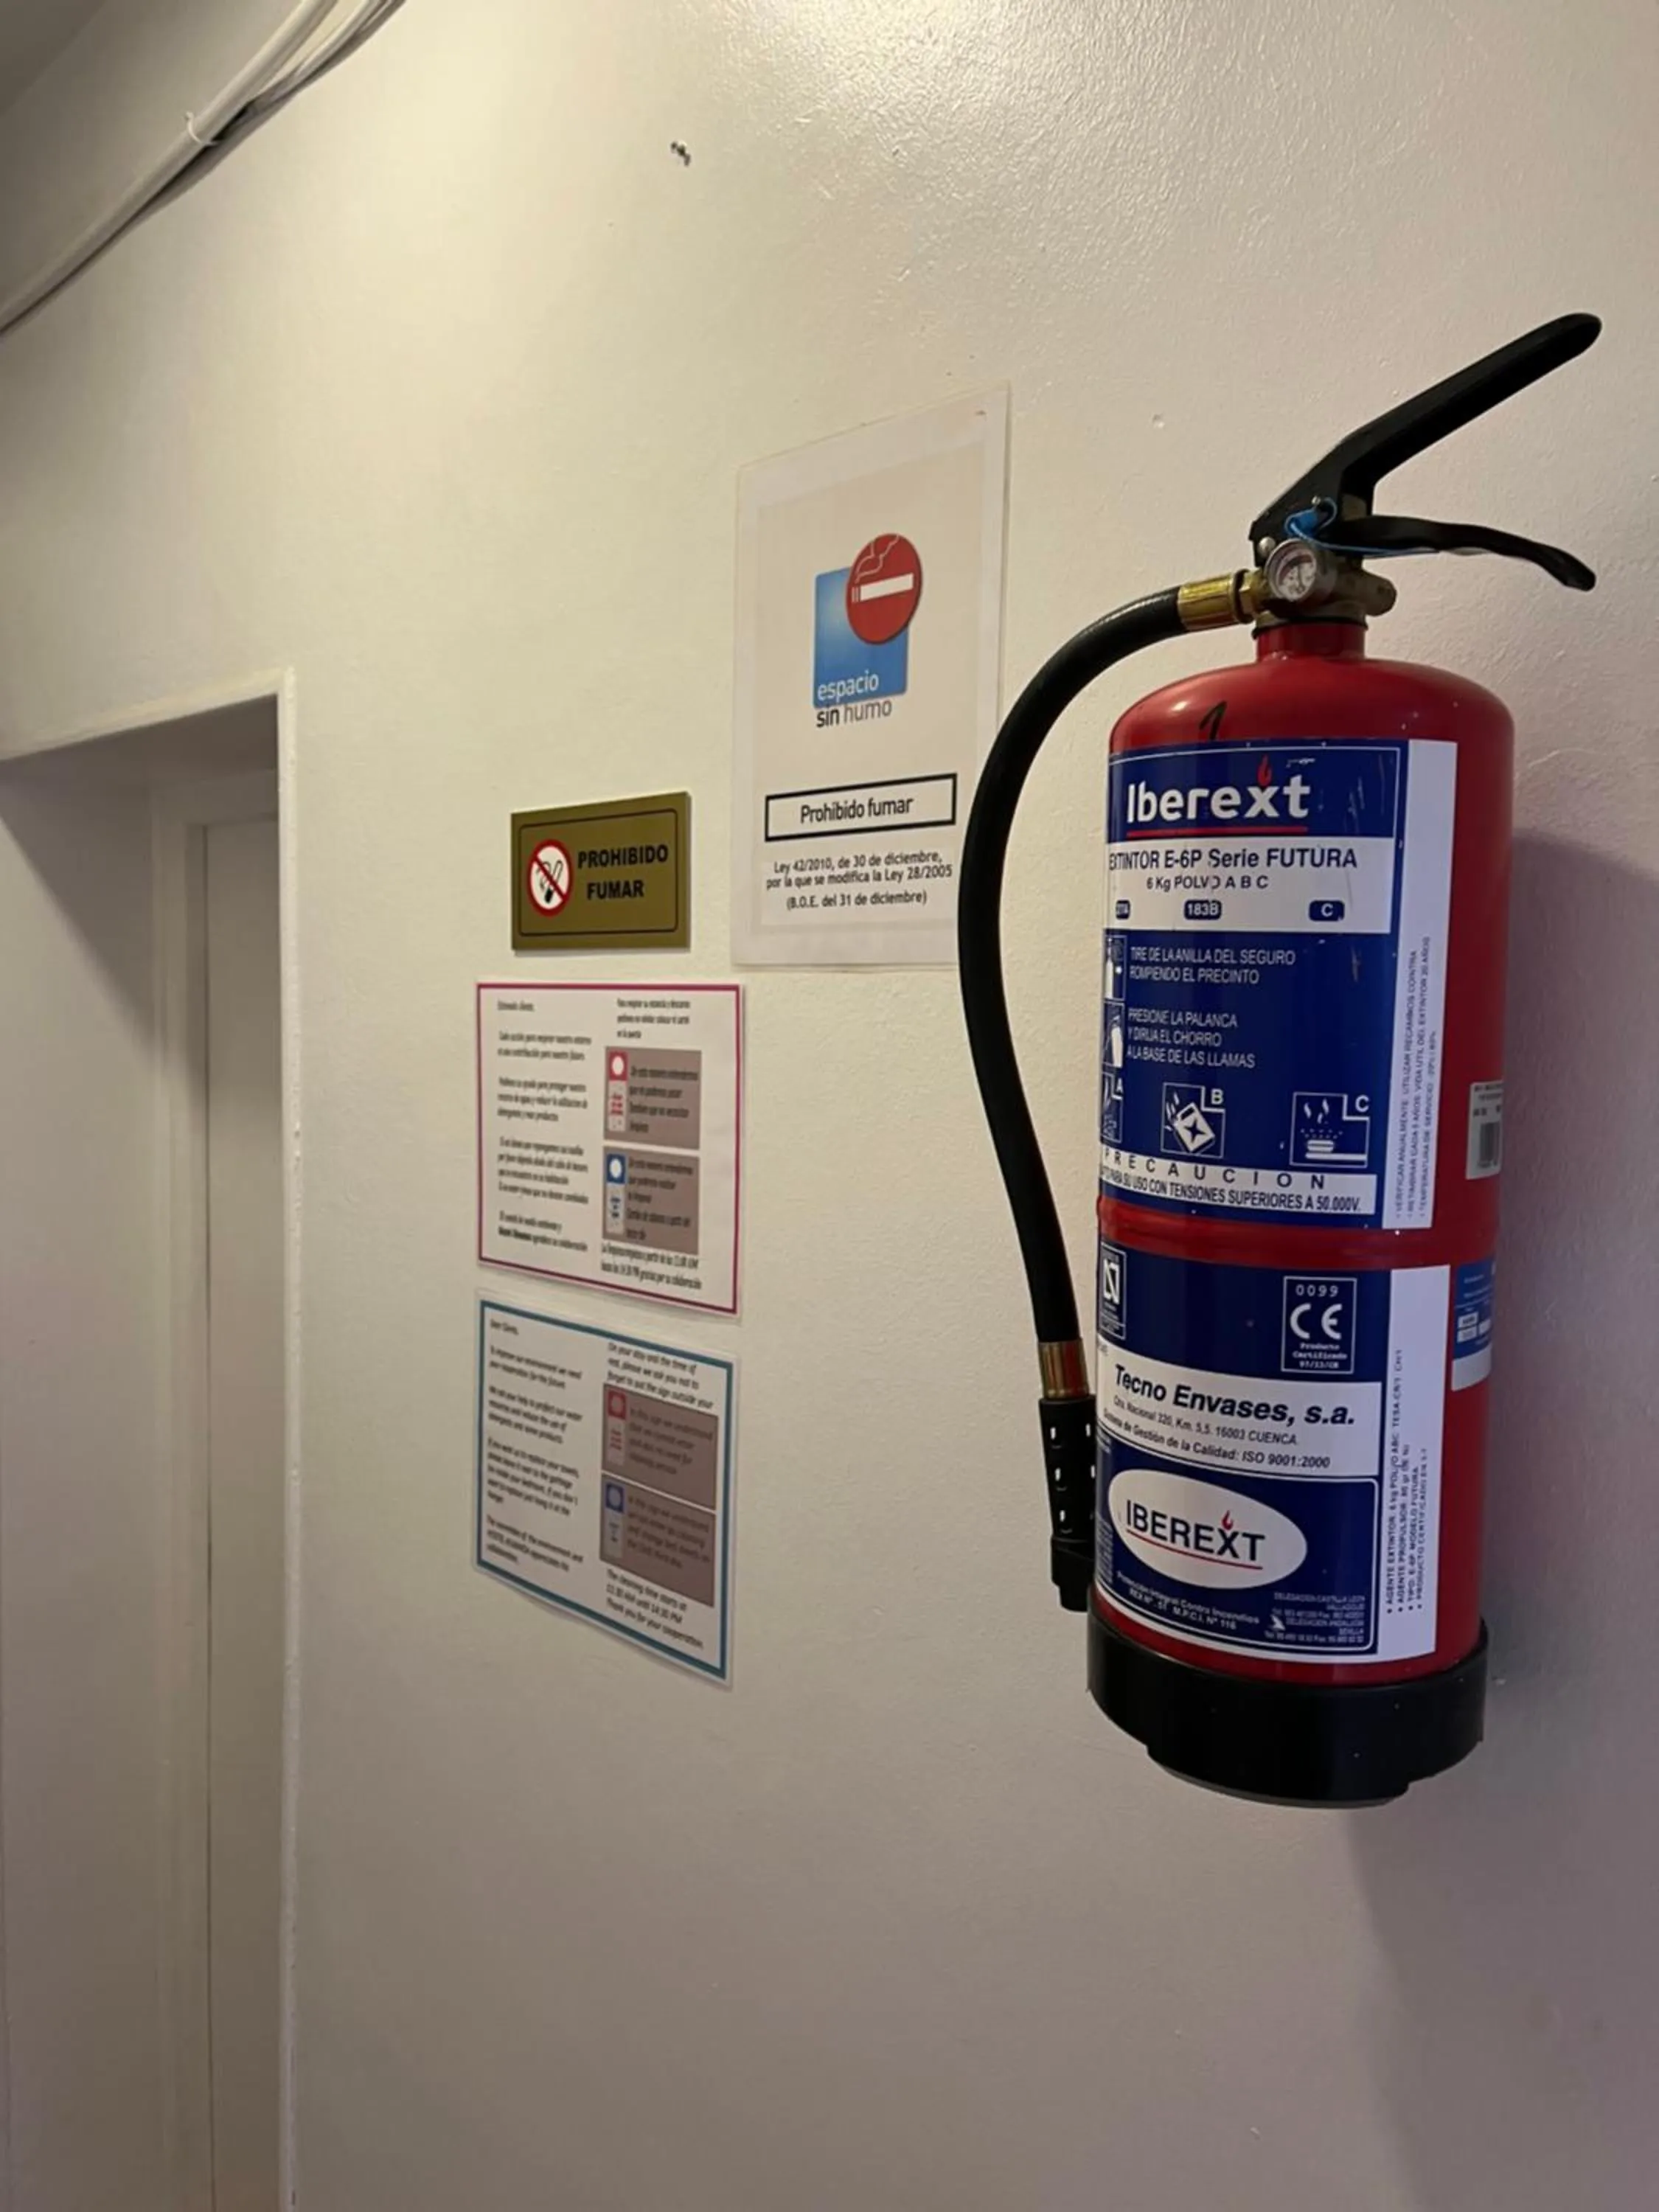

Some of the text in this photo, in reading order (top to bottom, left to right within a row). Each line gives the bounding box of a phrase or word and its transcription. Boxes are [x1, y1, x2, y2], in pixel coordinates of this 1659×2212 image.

[818, 669, 880, 701] espacio
[816, 700, 892, 728] sin humo
[800, 796, 914, 824] Prohibido fumar
[1127, 774, 1311, 824] Iberext
[578, 844, 668, 869] PROHIBIDO
[774, 850, 942, 877] Ley 42/2010, de 30 de diciembre,
[1164, 849, 1203, 869] E-6P
[1208, 848, 1259, 869] Serie
[1266, 848, 1357, 869] FUTURA
[766, 864, 953, 890] por la que se modifica la Ley 28/2005
[1147, 877, 1152, 889] 6
[1155, 877, 1171, 892] Kg
[1225, 875, 1236, 888] A
[1241, 875, 1251, 888] B
[1256, 875, 1269, 888] C
[587, 880, 644, 900] FUMAR
[786, 889, 928, 911] (B.O.E. del 31 de diciembre)
[1187, 902, 1220, 916] 183B
[1321, 903, 1333, 917] C
[1149, 947, 1161, 962] DE
[1162, 948, 1174, 962] LA
[1175, 948, 1215, 964] ANILLA
[1215, 949, 1238, 964] DEL
[1240, 950, 1295, 966] SEGURO
[1183, 967, 1195, 982] EL
[1197, 968, 1259, 984] PRECINTO
[1170, 1011, 1183, 1026] LA
[1186, 1012, 1237, 1028] PALANCA
[1160, 1029, 1172, 1045] EL
[1173, 1030, 1222, 1047] CHORRO
[1143, 1046, 1165, 1062] BASE
[1167, 1048, 1182, 1064] DE
[1184, 1049, 1205, 1065] LAS
[1207, 1052, 1256, 1068] LLAMAS
[1211, 1088, 1224, 1105] B
[1354, 1095, 1369, 1112] C
[1149, 1178, 1167, 1194] CON
[1169, 1181, 1225, 1203] TENSIONES
[1228, 1189, 1302, 1209] SUPERIORES
[1304, 1195, 1314, 1210] A
[1290, 1303, 1343, 1340] CE
[1115, 1363, 1354, 1427] Tecno Envases, s.a.
[1166, 1436, 1178, 1448] de
[1181, 1439, 1190, 1451] la
[1193, 1441, 1239, 1461] Calidad:
[1242, 1450, 1265, 1464] ISO
[1268, 1453, 1331, 1468] 9001:2000
[1410, 1467, 1419, 1506] FUTURA
[1126, 1500, 1265, 1562] IBEREXT
[1385, 1567, 1394, 1604] AGENTE
[1397, 1566, 1405, 1603] AGENTE
